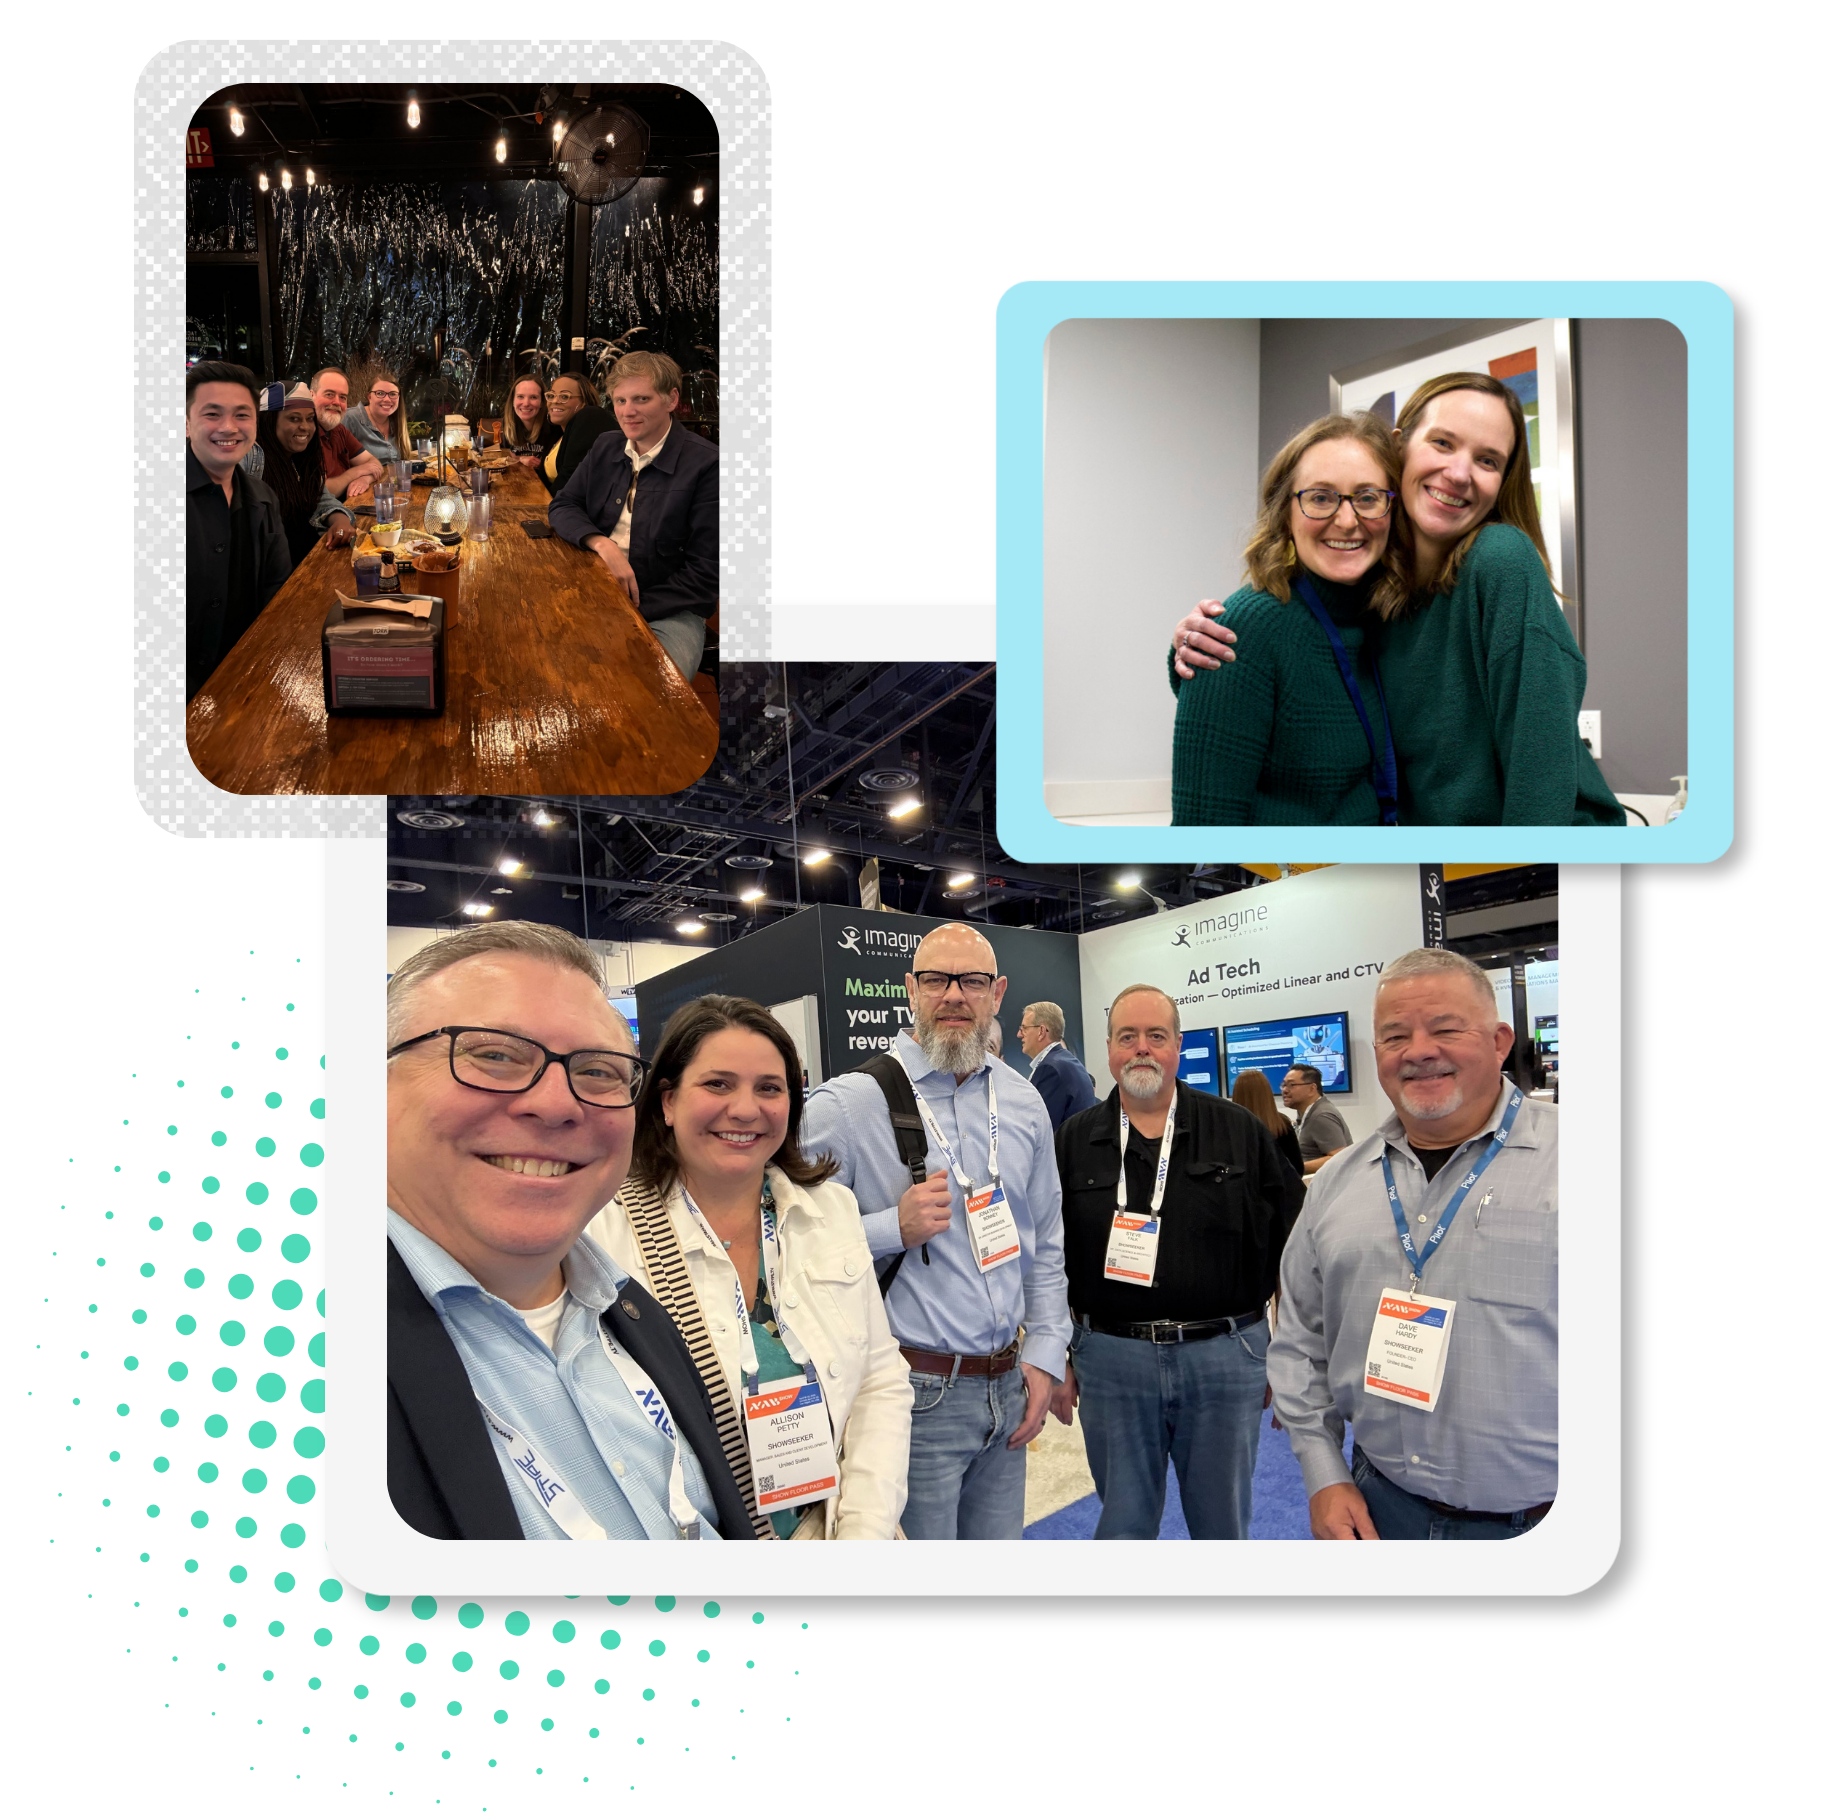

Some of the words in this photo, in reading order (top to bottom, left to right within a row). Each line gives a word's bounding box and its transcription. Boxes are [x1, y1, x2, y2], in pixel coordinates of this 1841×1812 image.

[186, 131, 202, 164] IT
[864, 929, 923, 952] imagin
[1196, 926, 1269, 946] COMMUNICATIONS
[866, 950, 912, 958] COMMUNICA
[1187, 967, 1210, 986] Ad
[1216, 958, 1260, 981] Tech
[1528, 972, 1558, 980] MANAGEM
[845, 978, 910, 998] Maxim
[1174, 994, 1204, 1006] zation
[1221, 979, 1280, 1001] Optimized
[1284, 974, 1322, 989] Linear
[1326, 968, 1350, 982] and
[1354, 962, 1384, 978] CTV
[846, 1008, 888, 1028] your
[893, 1006, 916, 1024] TV
[1510, 1094, 1522, 1108] Pilot
[1495, 1128, 1509, 1143] Pilot
[1461, 1172, 1478, 1189] Pilot
[1388, 1185, 1398, 1202] Pilot
[1429, 1224, 1446, 1244] Pilot
[1401, 1234, 1414, 1252] Pilot
[1382, 1302, 1409, 1314] NAB
[1395, 1330, 1417, 1340] HARDY
[1398, 1322, 1418, 1333] DAVE
[1384, 1340, 1424, 1354] SHOWSEEKER
[1376, 1381, 1390, 1389] SHOW
[749, 1398, 780, 1412] NAB
[770, 1411, 805, 1426] ALLISON
[777, 1422, 800, 1433] PETTY
[768, 1433, 814, 1450] SHOWSEEKER
[804, 1441, 828, 1451] DEVELOPMENT
[778, 1461, 794, 1469] United
[795, 1457, 810, 1465] States
[513, 1448, 565, 1508] STYPE
[772, 1491, 789, 1500] SHOW
[790, 1486, 809, 1496] FLOOR
[810, 1482, 824, 1491] PASS
